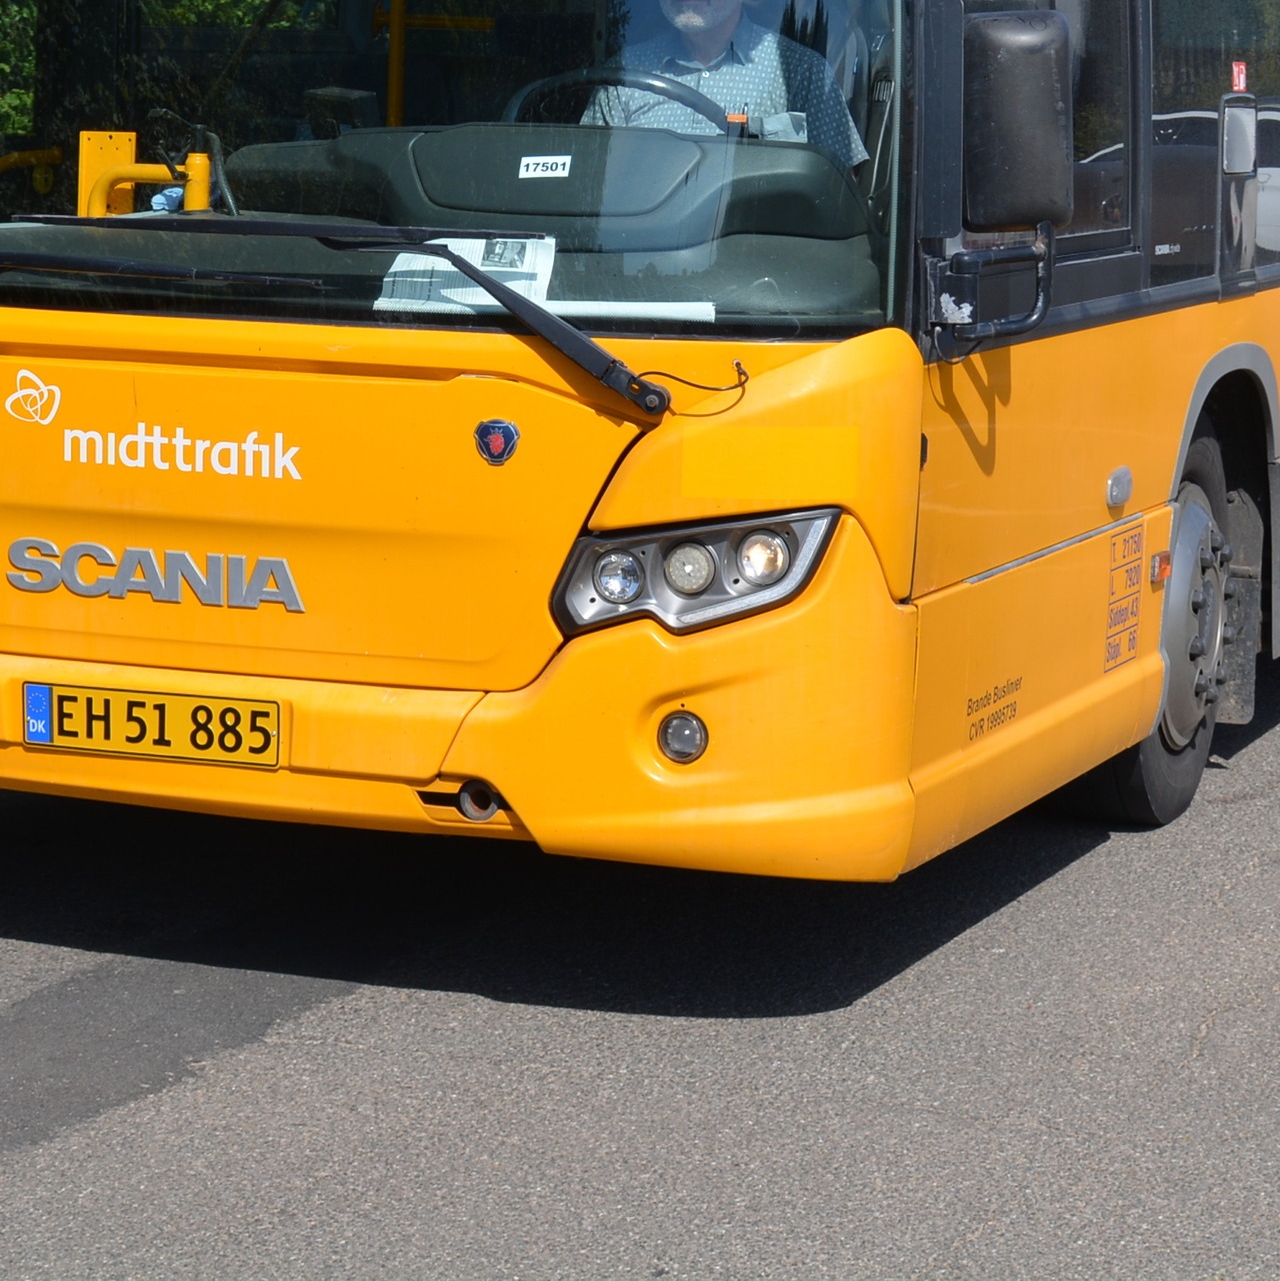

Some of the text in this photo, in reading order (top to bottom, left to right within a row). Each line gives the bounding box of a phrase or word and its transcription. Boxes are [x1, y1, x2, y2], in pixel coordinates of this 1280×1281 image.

[524, 161, 567, 173] 17501
[63, 422, 303, 480] midttrafik
[5, 536, 306, 613] SCANIA
[966, 689, 992, 717] Brande
[28, 719, 46, 734] DK
[57, 694, 272, 755] EH 51 885
[968, 717, 985, 741] CVR
